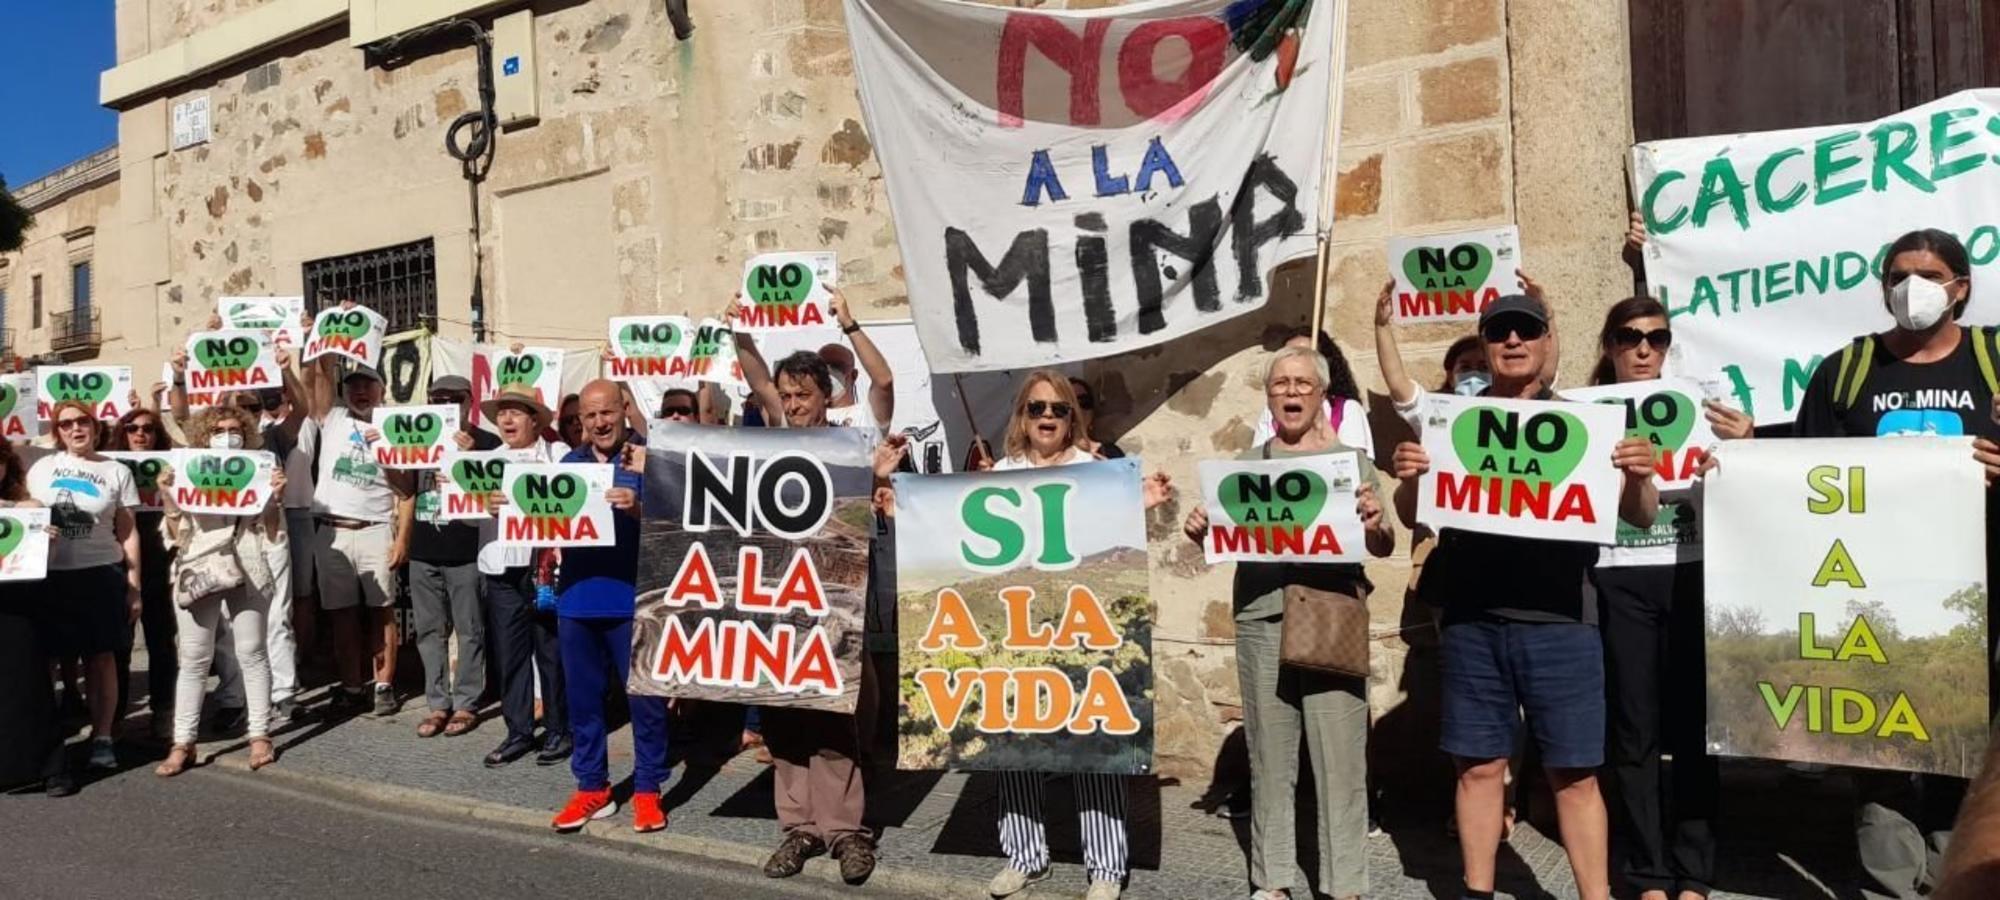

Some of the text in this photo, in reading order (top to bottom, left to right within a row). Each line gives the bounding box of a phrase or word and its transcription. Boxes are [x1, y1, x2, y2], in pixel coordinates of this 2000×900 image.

[997, 12, 1228, 128] NO
[1017, 136, 1185, 206] A LA
[1418, 244, 1479, 274] NO
[757, 263, 803, 289] NO
[1426, 275, 1466, 288] A LA
[761, 290, 793, 302] A LA
[325, 310, 364, 327] NO
[739, 302, 824, 327] MINA
[630, 323, 673, 343] NO
[206, 337, 250, 358] NO
[308, 334, 367, 361] MINA
[211, 358, 241, 367] A LA
[503, 354, 535, 374] NO
[611, 356, 686, 376] MINA
[58, 372, 104, 390] NO
[191, 366, 270, 388] MINA
[1873, 392, 1903, 413] NO
[1915, 388, 1976, 411] MINA
[394, 412, 434, 433] NO
[1476, 409, 1568, 454] NO
[409, 435, 425, 444] LA
[200, 455, 246, 476] NO
[463, 459, 505, 480] NO
[1480, 454, 1542, 475] A LA
[201, 477, 233, 486] A LA
[470, 481, 499, 491] A LA
[525, 473, 576, 499] NO
[684, 449, 832, 538] NO
[1237, 472, 1311, 503] NO
[1807, 465, 1866, 514] SI
[177, 487, 258, 508] MINA
[448, 493, 484, 514] MI
[530, 501, 563, 514] A LA
[1435, 471, 1597, 524] MINA
[960, 481, 1078, 568] SI
[1245, 507, 1294, 522] A LA
[506, 515, 599, 541] MINA
[1212, 524, 1344, 555] MINA
[1811, 538, 1867, 589] A
[666, 543, 828, 615] A LA
[919, 585, 1122, 650] A LA
[1799, 612, 1890, 664] LA
[653, 616, 842, 694] MINA
[915, 667, 1141, 735] VIDA
[1756, 681, 1932, 743] VIDA
